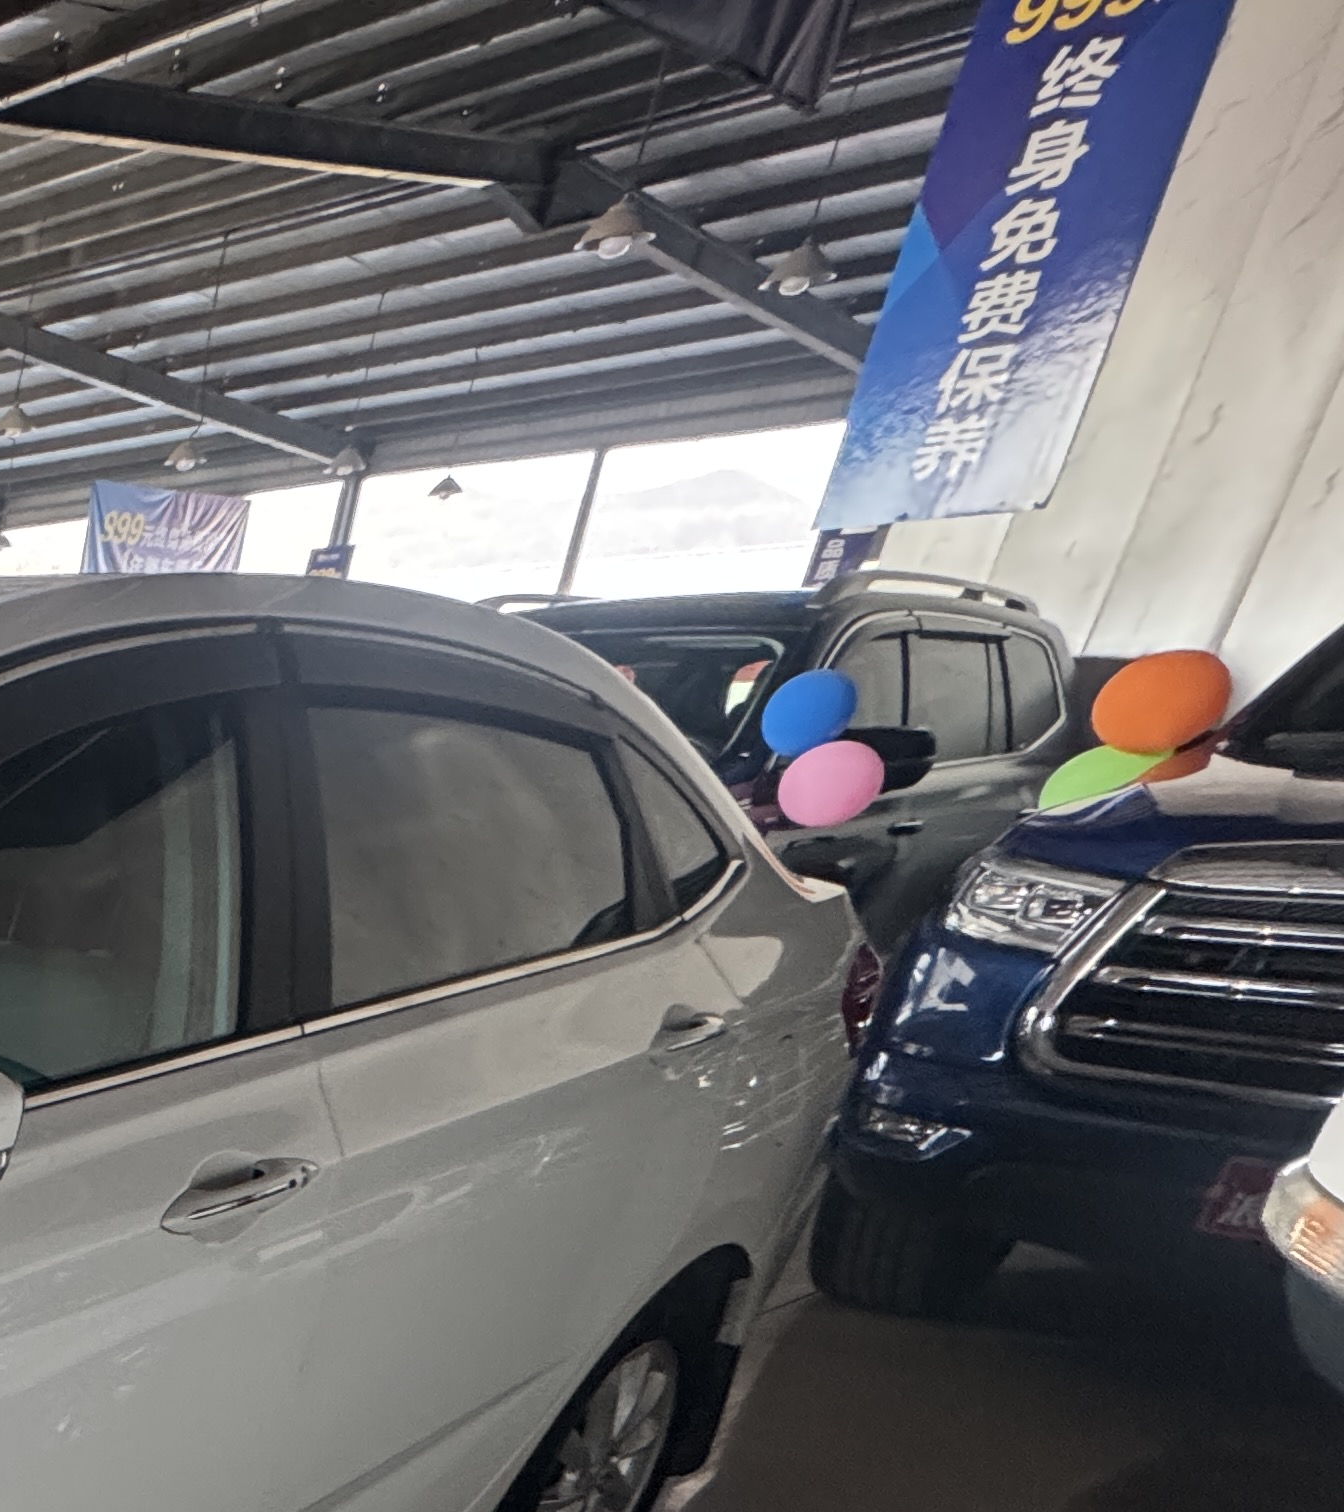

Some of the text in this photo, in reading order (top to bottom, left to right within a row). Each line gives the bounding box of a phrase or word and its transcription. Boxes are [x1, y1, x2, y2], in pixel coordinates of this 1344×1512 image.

[913, 37, 1126, 483] 终身免费保养
